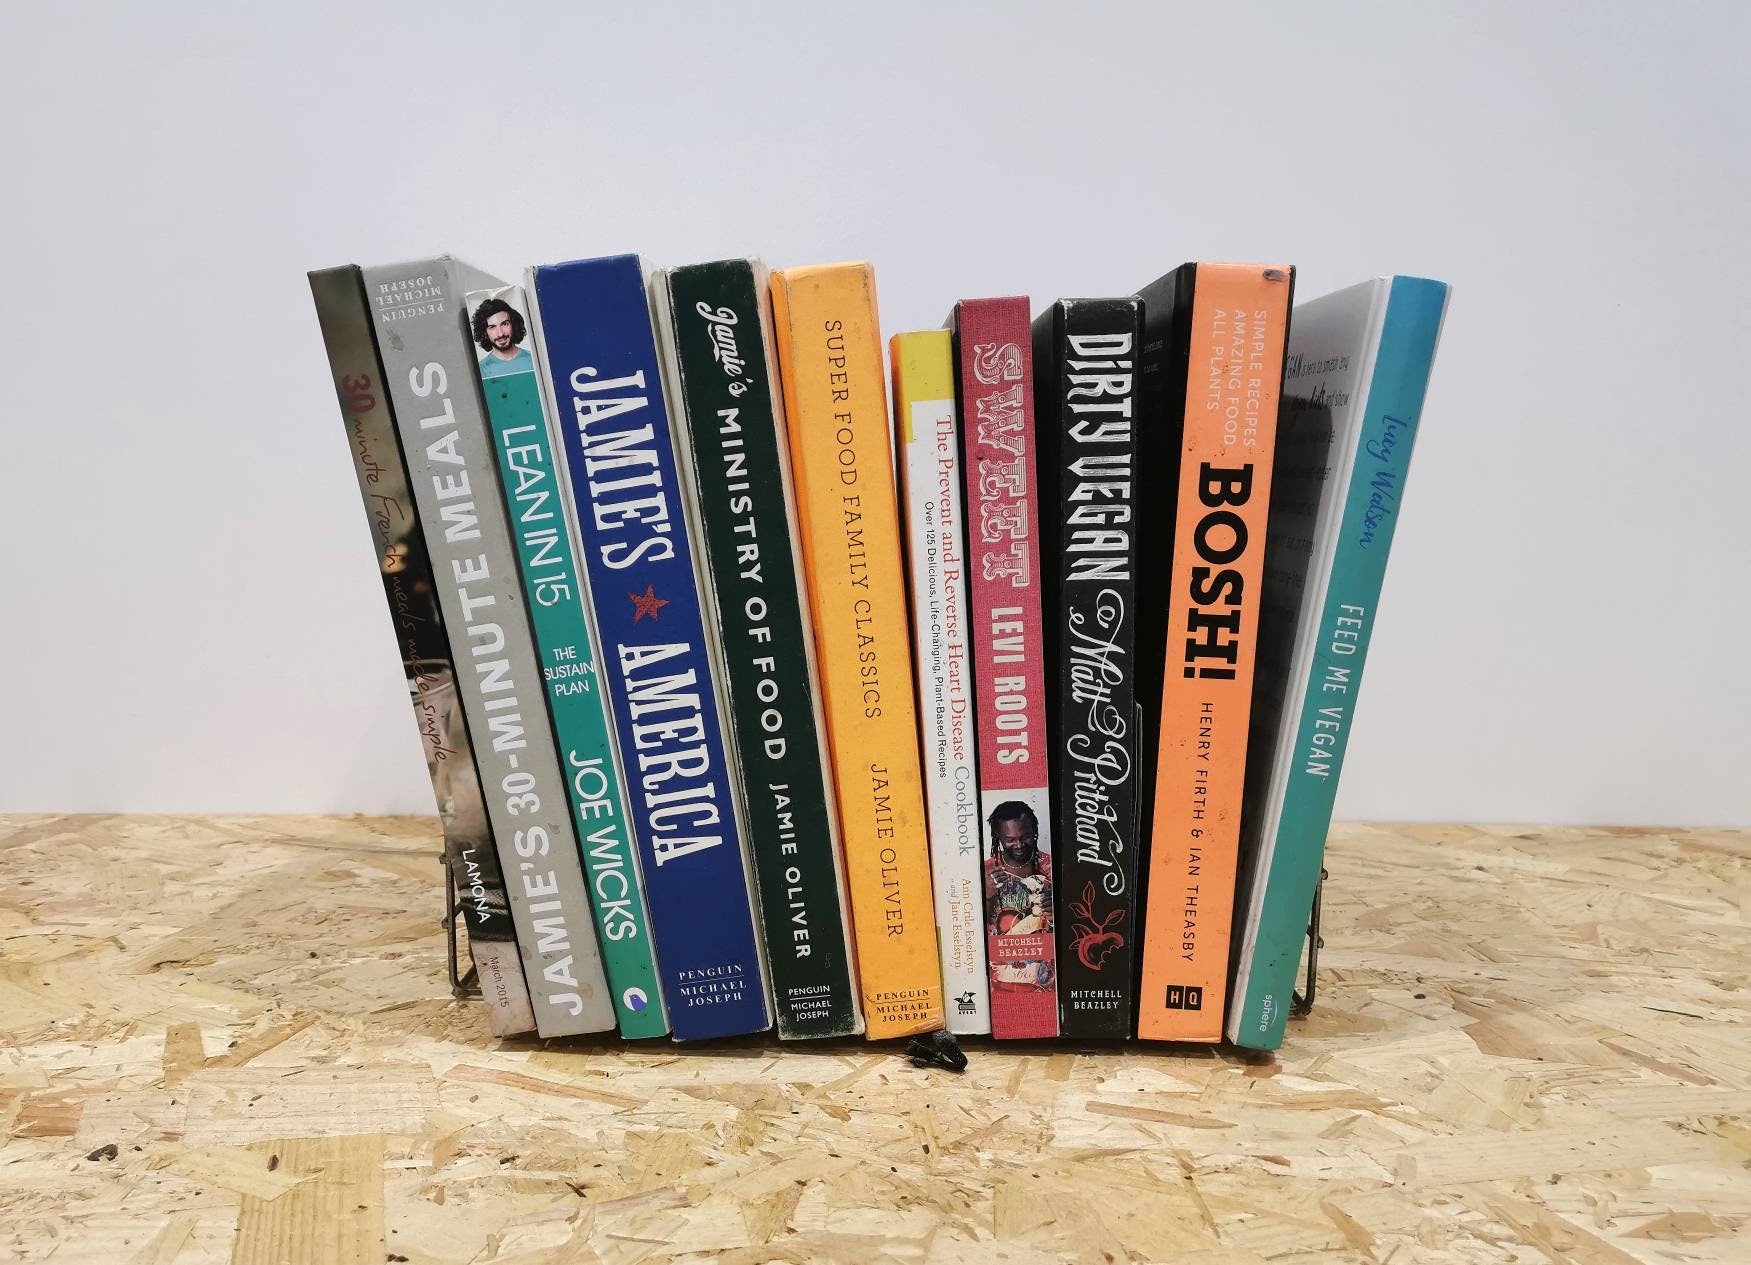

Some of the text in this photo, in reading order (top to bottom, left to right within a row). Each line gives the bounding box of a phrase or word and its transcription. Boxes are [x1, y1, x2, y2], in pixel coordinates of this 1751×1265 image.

[376, 286, 442, 306] MICHAEL
[380, 275, 432, 293] JOSEPH
[382, 303, 444, 323] PENGUIN
[1206, 308, 1227, 411] ALL PLANTS
[1223, 309, 1248, 446] AMAZING FOOD
[1242, 309, 1267, 447] SIMPLE RECIPES
[342, 373, 376, 414] 30
[354, 419, 386, 486] minute
[973, 341, 1030, 588] SWEET
[370, 493, 405, 568] French
[502, 424, 572, 607] LEAN IN 15
[695, 301, 787, 761] Jamie's MINISTRY OF FOOD
[824, 319, 882, 719] SUPER FOOD FAMILY CLASSICS
[1065, 452, 1131, 581] VEGAN
[1359, 471, 1397, 550] Watson
[1183, 460, 1254, 681] BOSH!
[392, 575, 426, 632] meals
[570, 366, 723, 867] JAMIE'S AMERICA
[552, 646, 577, 660] THE
[924, 501, 947, 779] Over 125 Delicious, Life-Changing, Plant-Based Recipes
[936, 414, 977, 857] The Prevent and Reverse Heart Disease Cookbook
[408, 361, 583, 1016] JAMIE'S 30-MINUTE MEALS
[544, 660, 595, 681] SUSTAIN
[554, 679, 590, 697] PLAN
[991, 606, 1030, 766] LEVI ROOTS
[1305, 602, 1365, 777] FEED ME VEGAN
[422, 702, 457, 765] simple
[1066, 588, 1131, 896] Matt Pritchard
[569, 749, 638, 942] JOE WICKS
[870, 763, 904, 939] JAMIE OLIVER
[1181, 702, 1214, 963] HENRY FIRTH & IAN THEASBY
[462, 849, 491, 924] LAMONA
[768, 782, 811, 960] JAMIE OLIVER
[962, 878, 972, 899] Ann
[948, 900, 961, 922] Jane
[997, 937, 1043, 947] MITCHELL
[998, 947, 1044, 957] BEAZLEY
[489, 956, 510, 1008] March 2015
[678, 964, 743, 981] PENGUIN
[679, 980, 747, 997] MICHAEL
[687, 991, 743, 1008] JOSEPH
[787, 984, 831, 997] PENGUIN
[876, 988, 930, 1001] PENGUIN
[1070, 989, 1122, 999] MITCHELL
[790, 998, 832, 1012] MICHAEL
[795, 1008, 830, 1022] JOSEPH
[876, 1001, 933, 1015] MICHAEL
[881, 1010, 928, 1023] JOSEPH
[1073, 1000, 1120, 1010] BEAZLEY
[1259, 994, 1273, 1032] sphere
